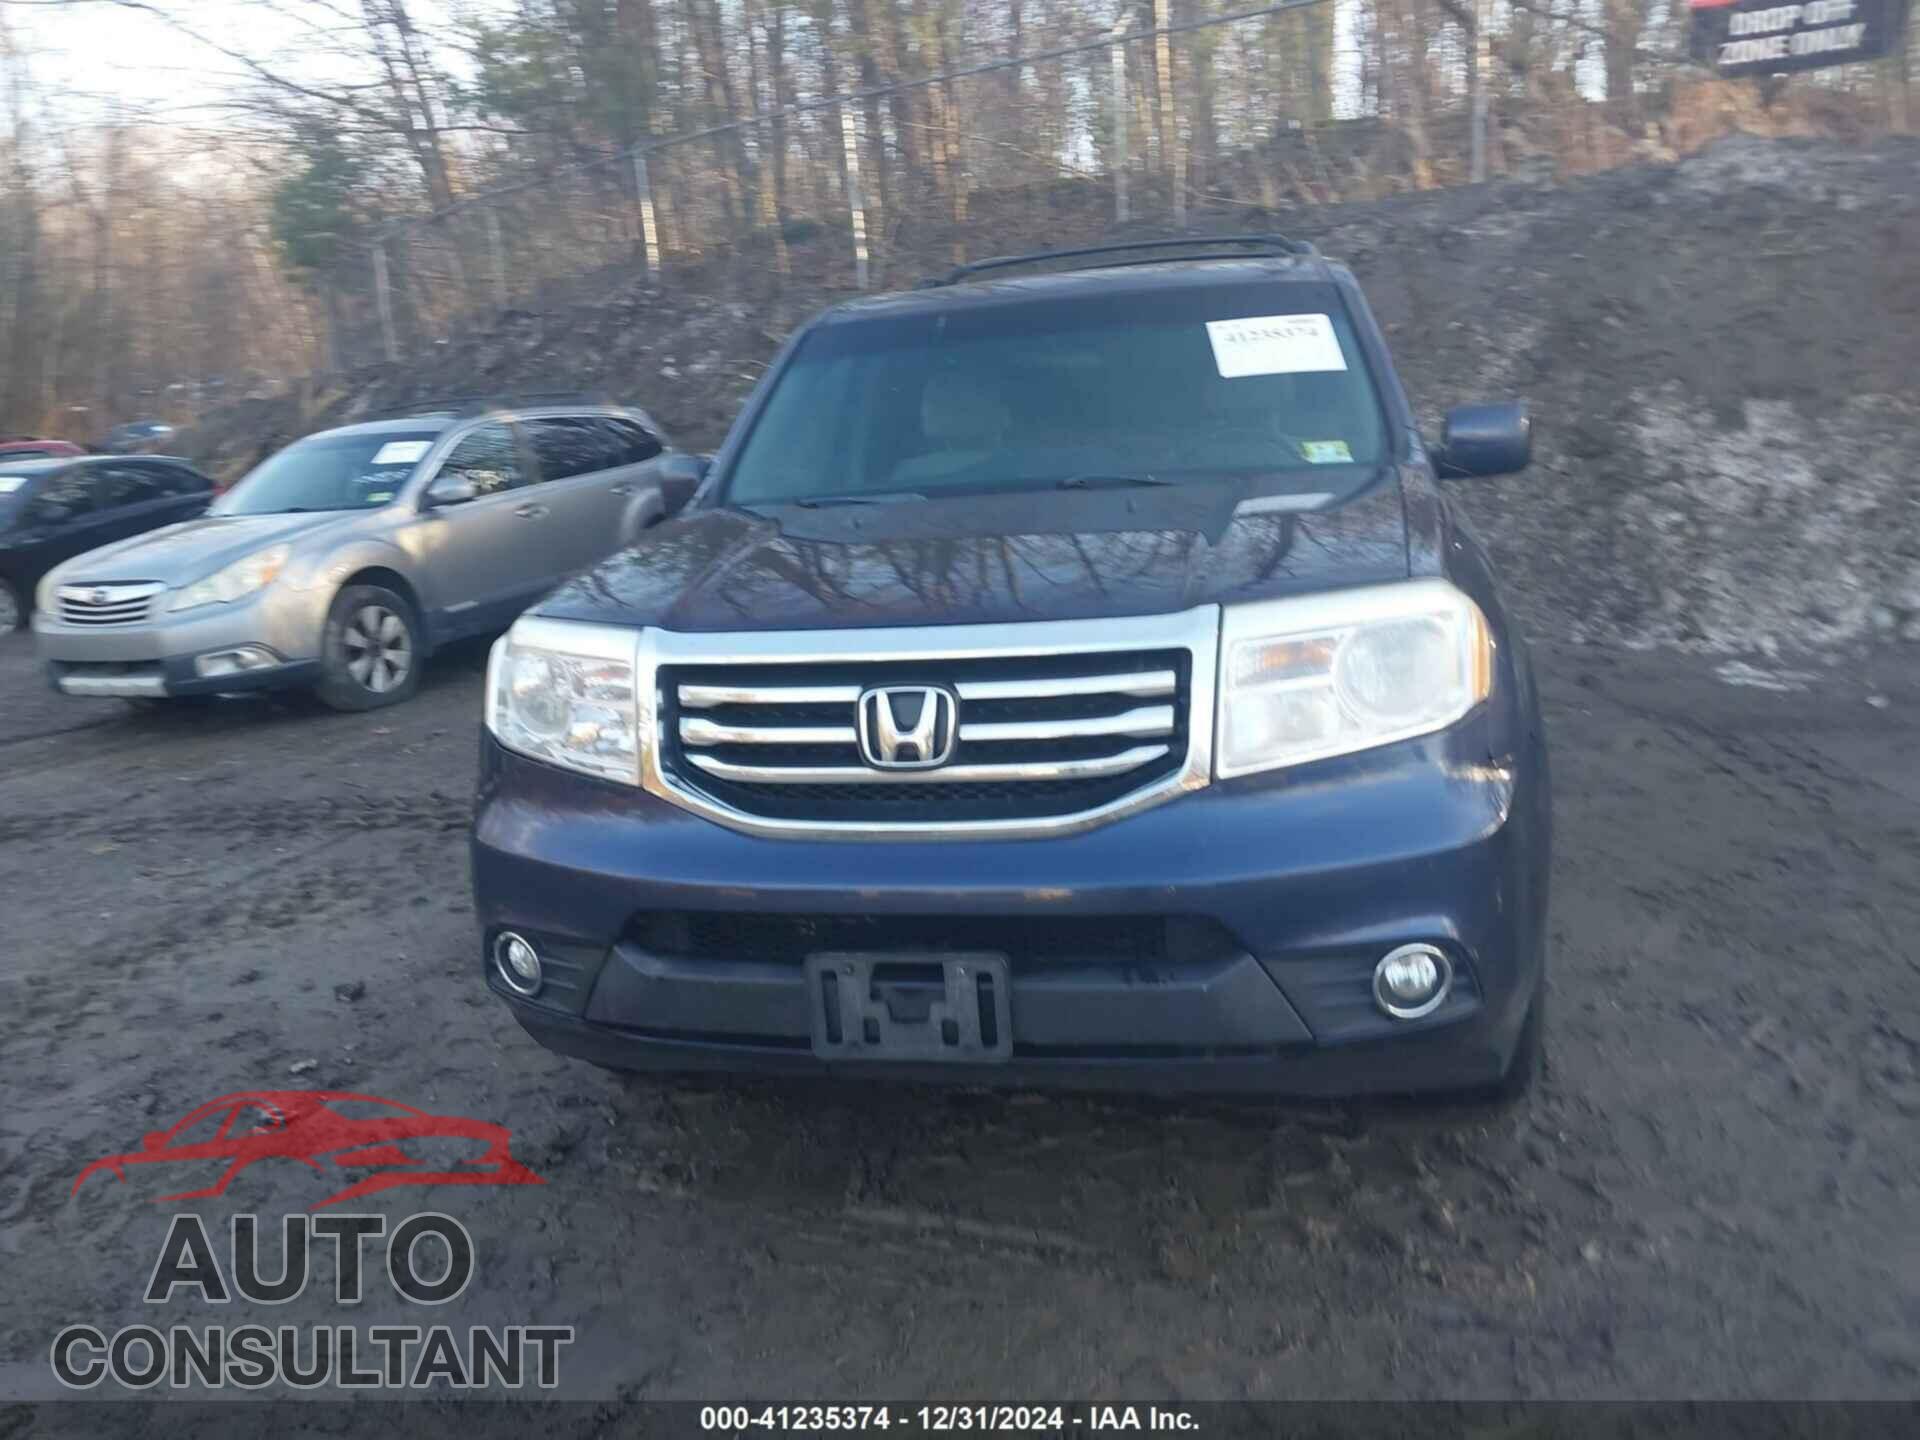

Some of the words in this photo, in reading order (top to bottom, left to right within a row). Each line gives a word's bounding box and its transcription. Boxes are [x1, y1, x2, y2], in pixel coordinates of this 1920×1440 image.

[1729, 4, 1801, 35] DROP
[1717, 35, 1789, 64] ZONE
[1789, 22, 1867, 55] ONLY
